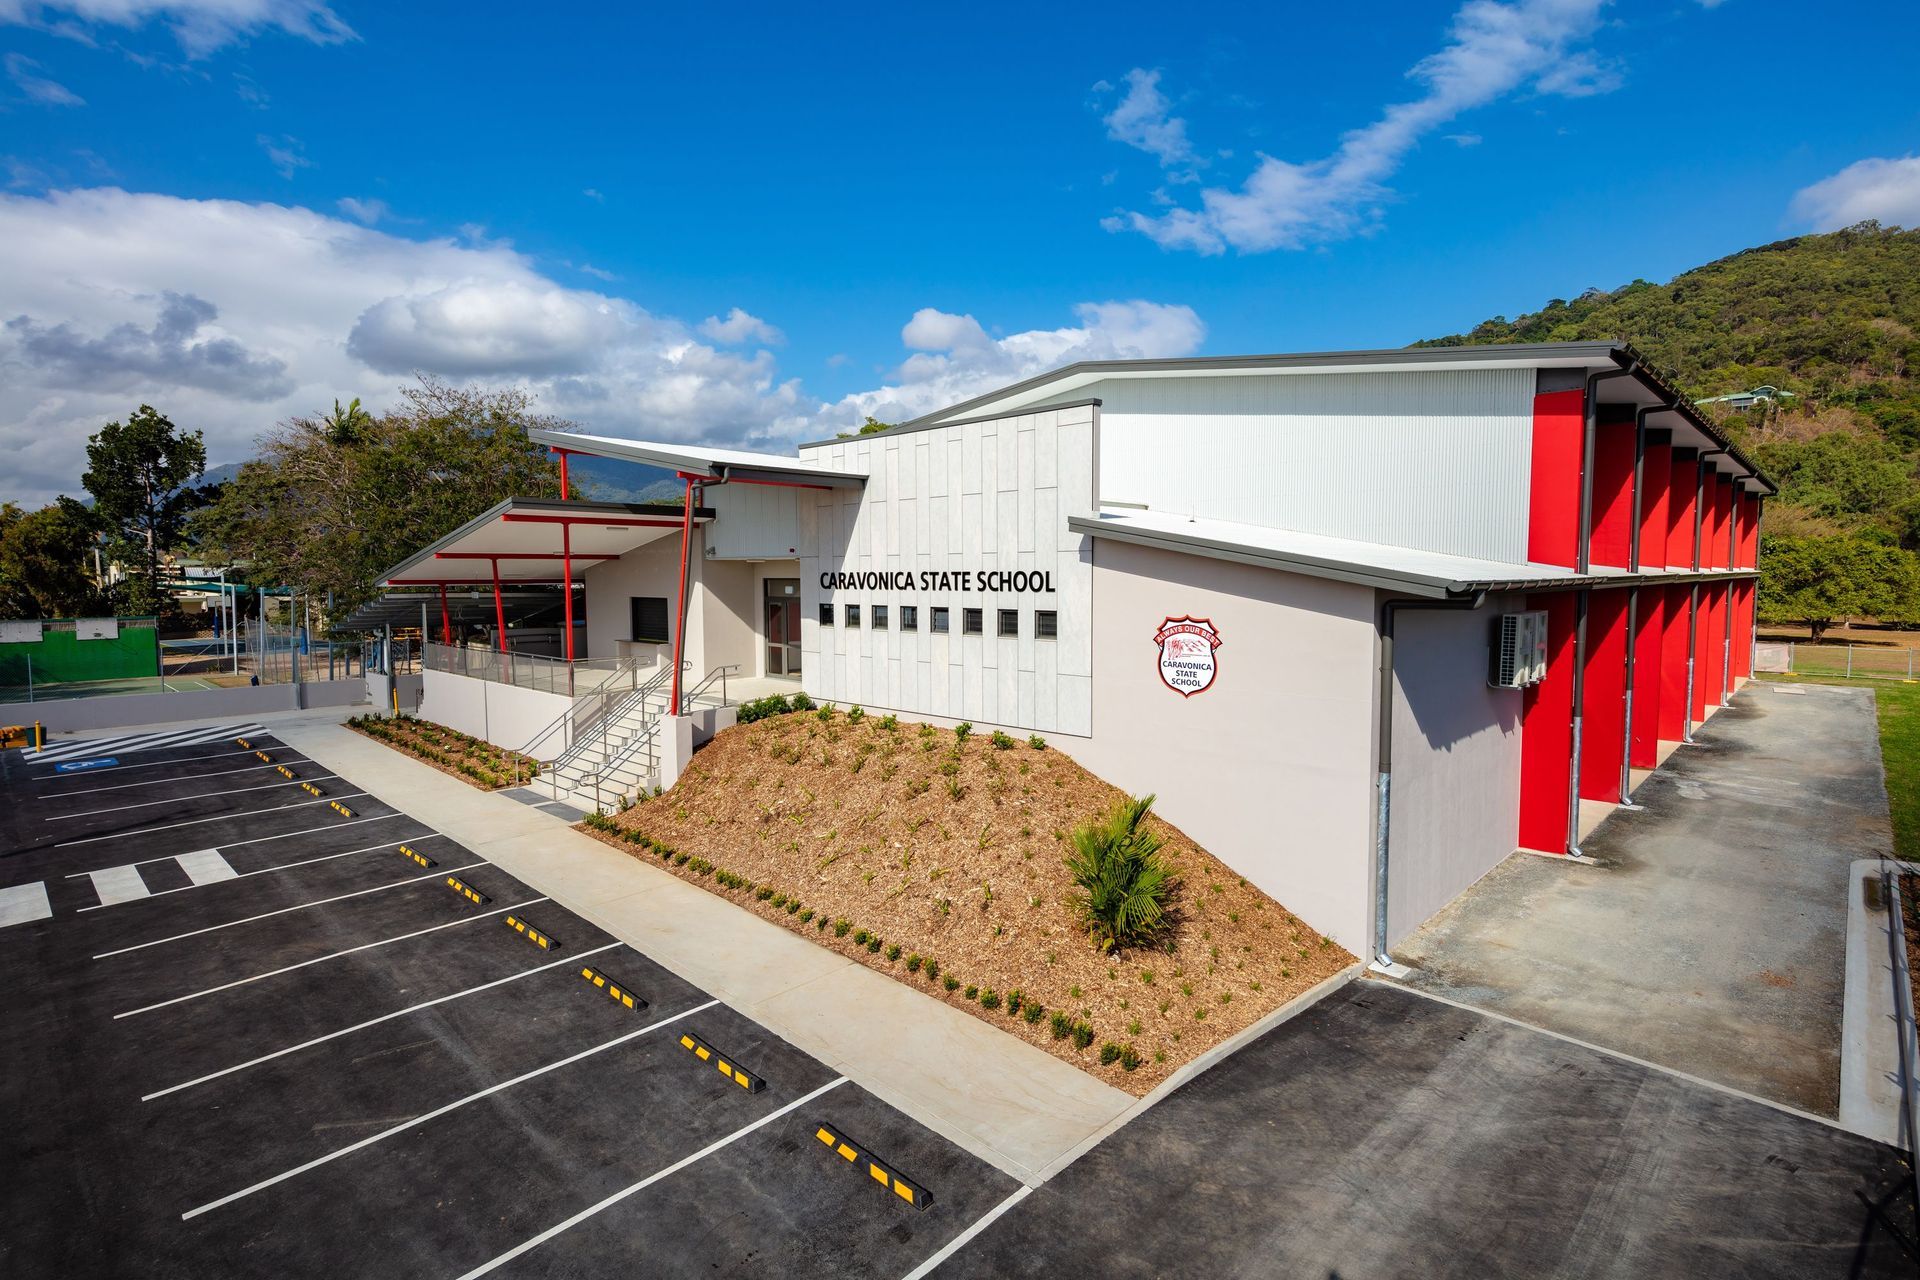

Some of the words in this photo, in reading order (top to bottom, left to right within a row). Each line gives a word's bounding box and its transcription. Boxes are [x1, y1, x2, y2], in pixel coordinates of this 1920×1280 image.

[820, 571, 916, 591] CARAVONICA
[921, 571, 971, 592] STATE
[977, 570, 1056, 593] SCHOOL
[1157, 626, 1183, 643] ALWAYS
[1184, 625, 1200, 634] OUR
[1201, 630, 1219, 647] BEST
[1162, 660, 1212, 671] CARAVONICA
[1175, 670, 1198, 678] STATE
[1171, 678, 1202, 687] SCHOOL
